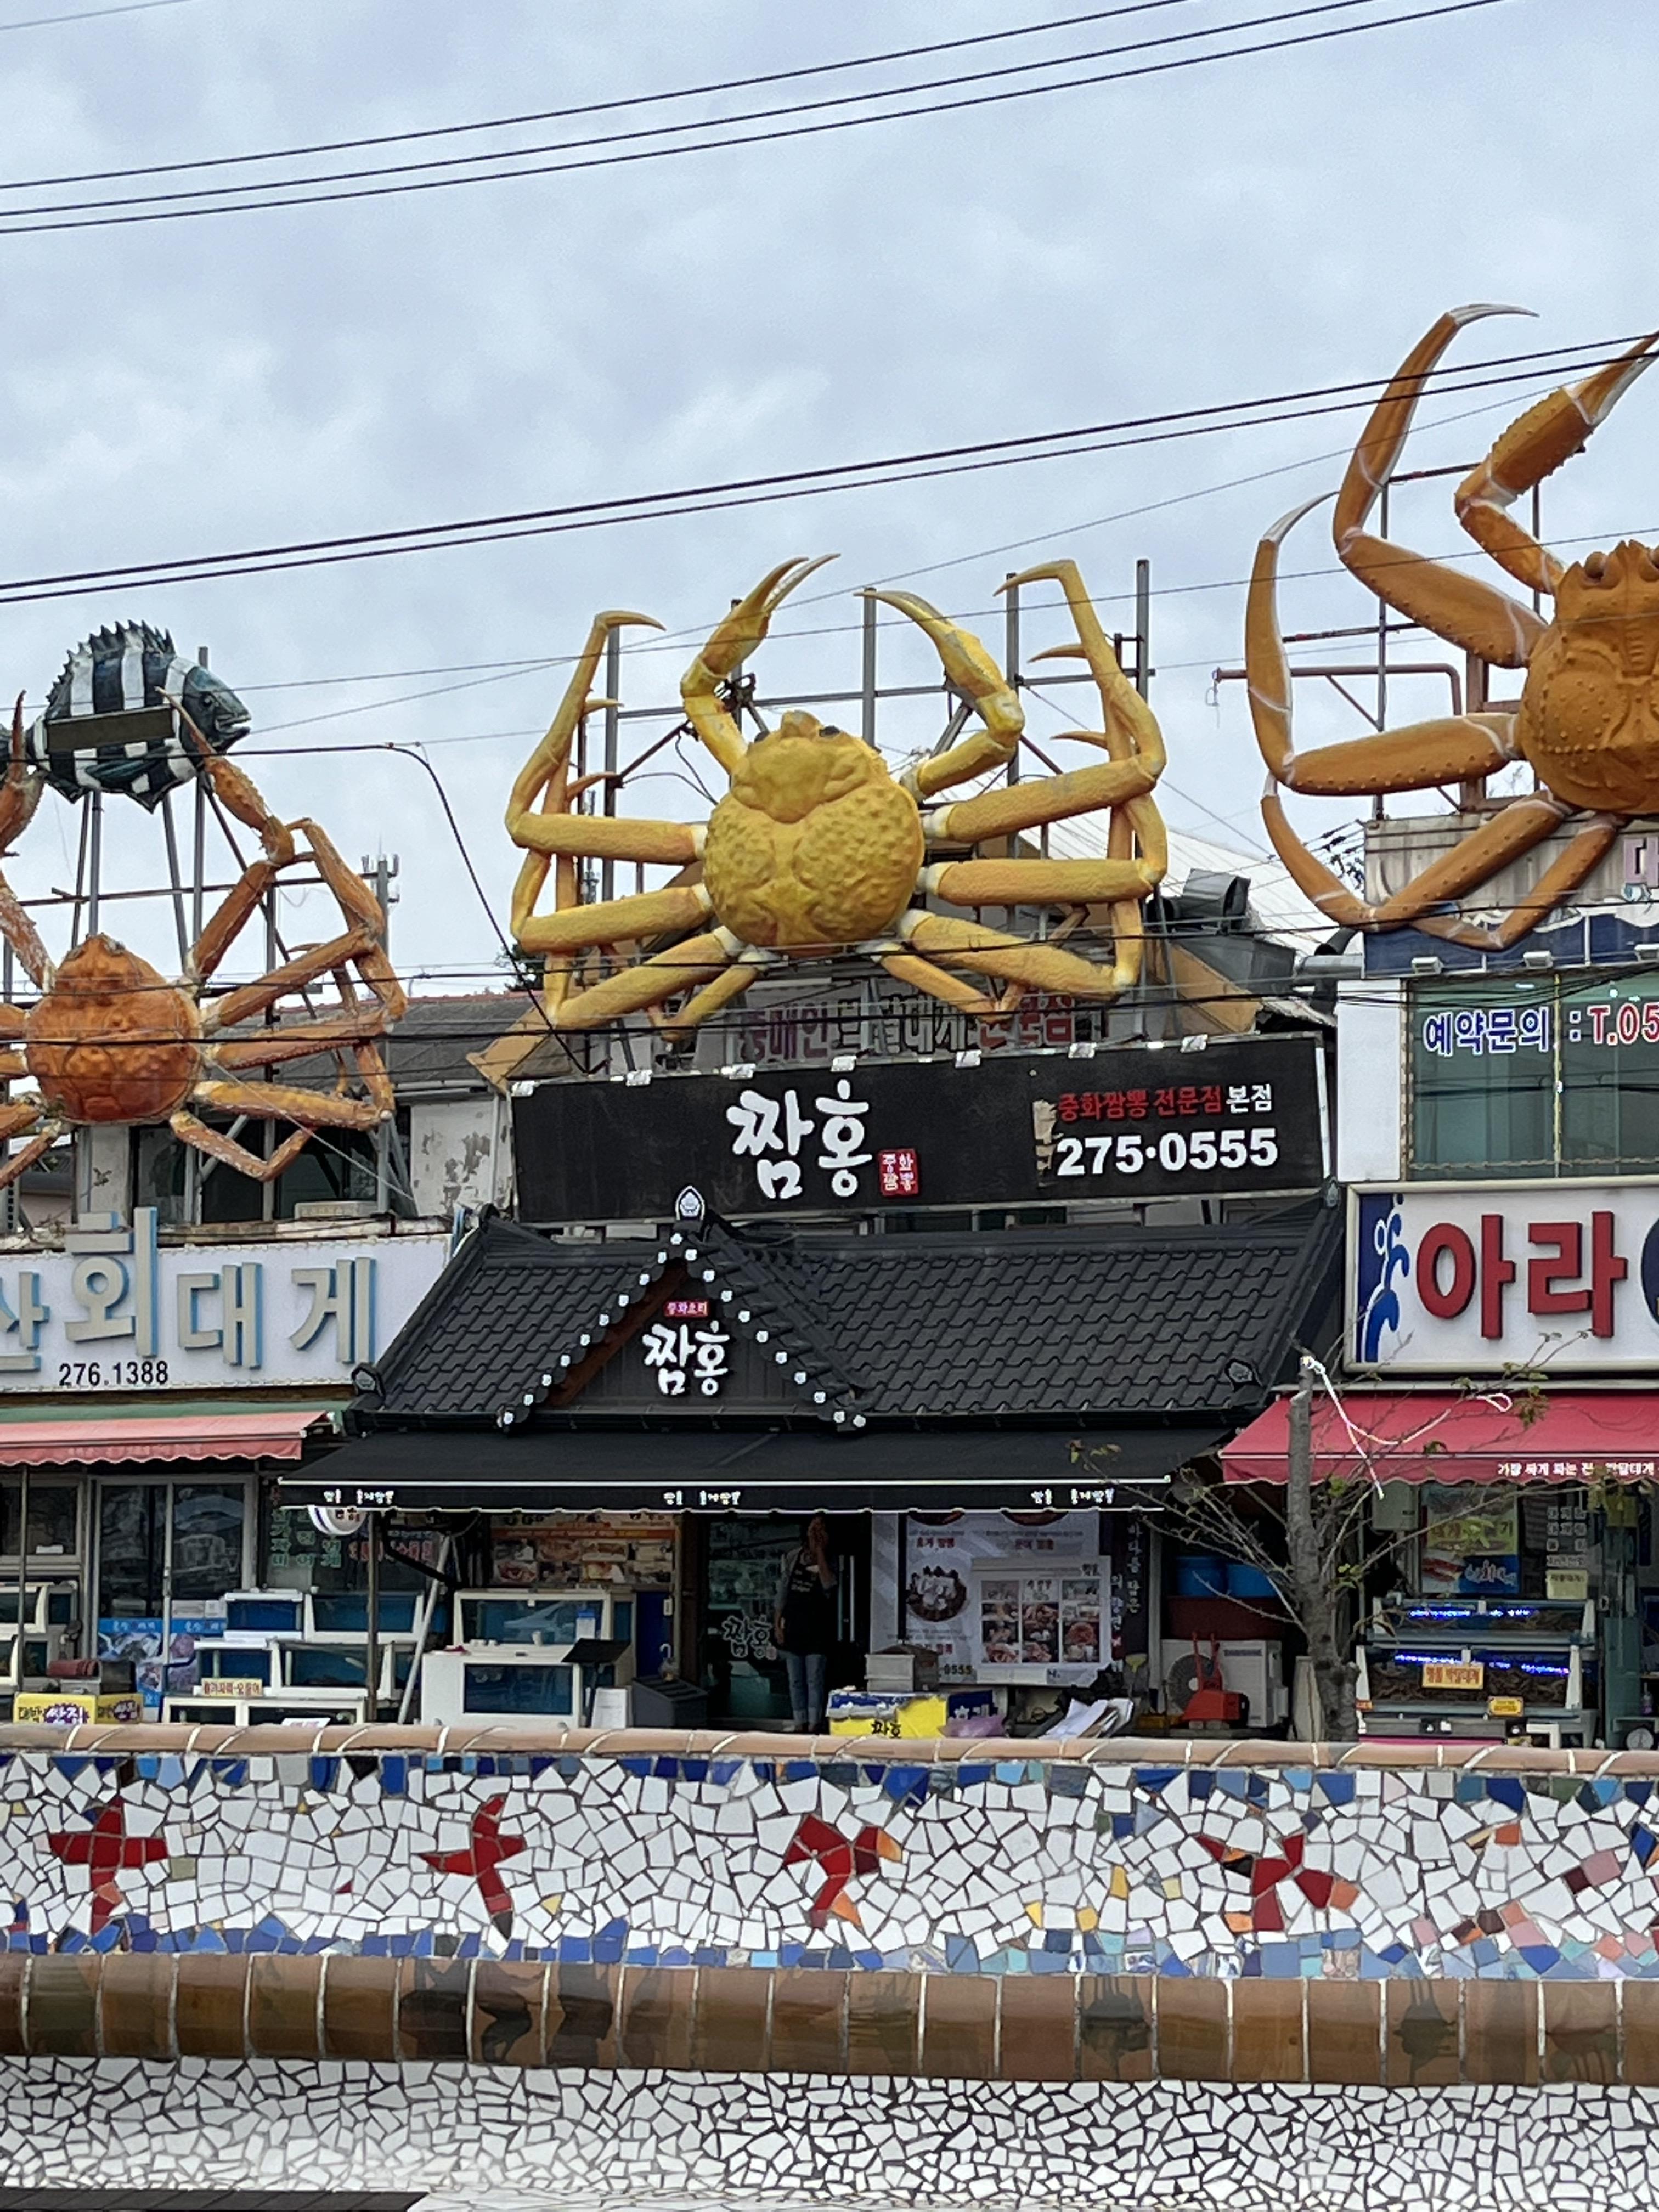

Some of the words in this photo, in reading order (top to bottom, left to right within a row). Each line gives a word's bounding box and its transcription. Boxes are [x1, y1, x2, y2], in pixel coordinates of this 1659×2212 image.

[1425, 1007, 1549, 1055] 예약문의
[1058, 1088, 1149, 1122] 중화짬뽕
[1154, 1085, 1223, 1116] 전문점
[1226, 1084, 1272, 1114] 본점
[726, 1079, 873, 1200] 짬홍
[59, 1361, 168, 1387] 276.1388
[642, 1319, 730, 1396] 짬홍
